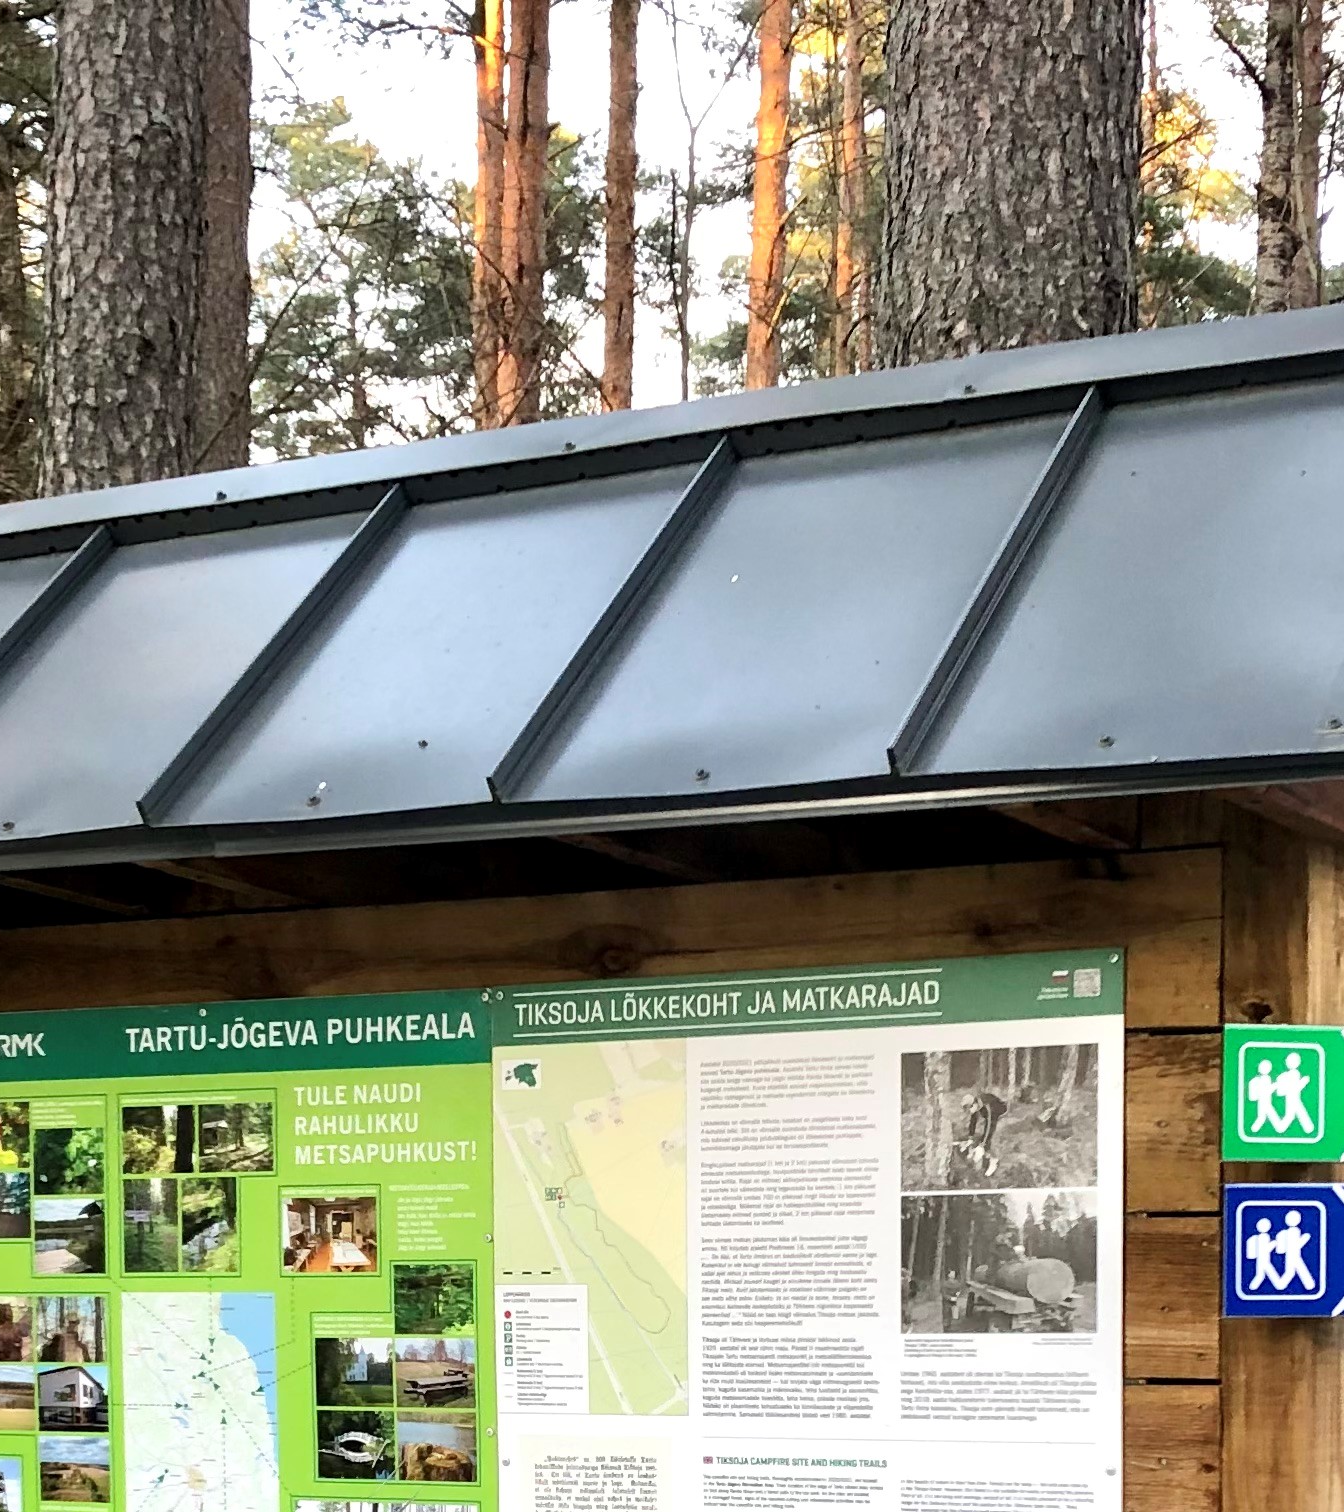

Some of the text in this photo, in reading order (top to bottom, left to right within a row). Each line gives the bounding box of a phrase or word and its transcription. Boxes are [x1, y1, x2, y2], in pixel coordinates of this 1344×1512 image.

[514, 980, 940, 1027] TIKSOJA LÕKKEKOHT JA MATKARAJAD
[125, 1012, 475, 1054] TARTU-JÕGEVA PUHKEALA
[294, 1083, 421, 1106] TULE NAUDI
[294, 1112, 419, 1136] RAHULIKKU
[294, 1140, 477, 1165] METSAPUHKUST!
[716, 1456, 888, 1468] TIKSOJA CAMPFIRE SITE AND HIKING TRAILS
